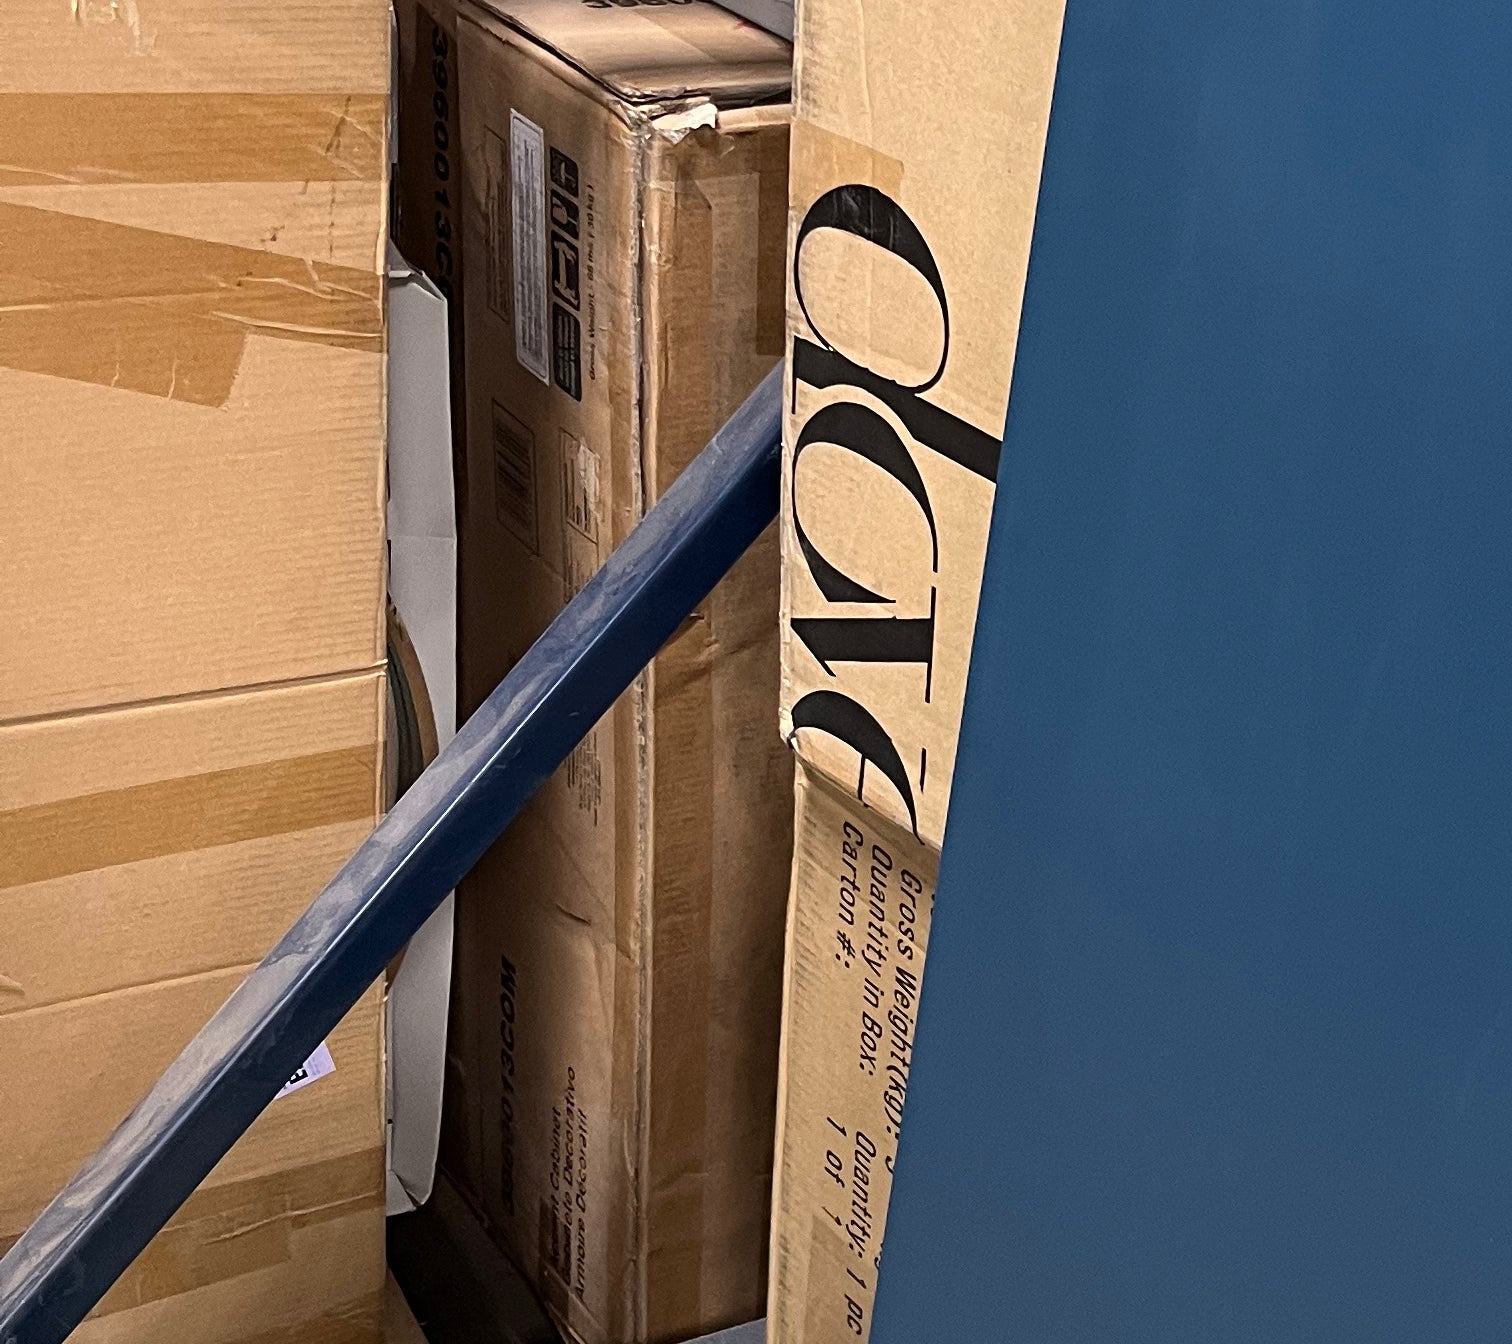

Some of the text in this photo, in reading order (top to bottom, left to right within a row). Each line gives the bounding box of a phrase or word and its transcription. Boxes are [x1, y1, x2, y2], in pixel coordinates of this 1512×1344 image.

[897, 868, 922, 961] Gross
[822, 821, 864, 1227] Carton #: 1 of 1
[563, 1066, 576, 1186] Decorativo
[845, 844, 893, 1338] Quantity in Box: Quantity: 1 pc
[550, 1106, 562, 1191] Cabinet
[574, 1216, 587, 1300] Armoire
